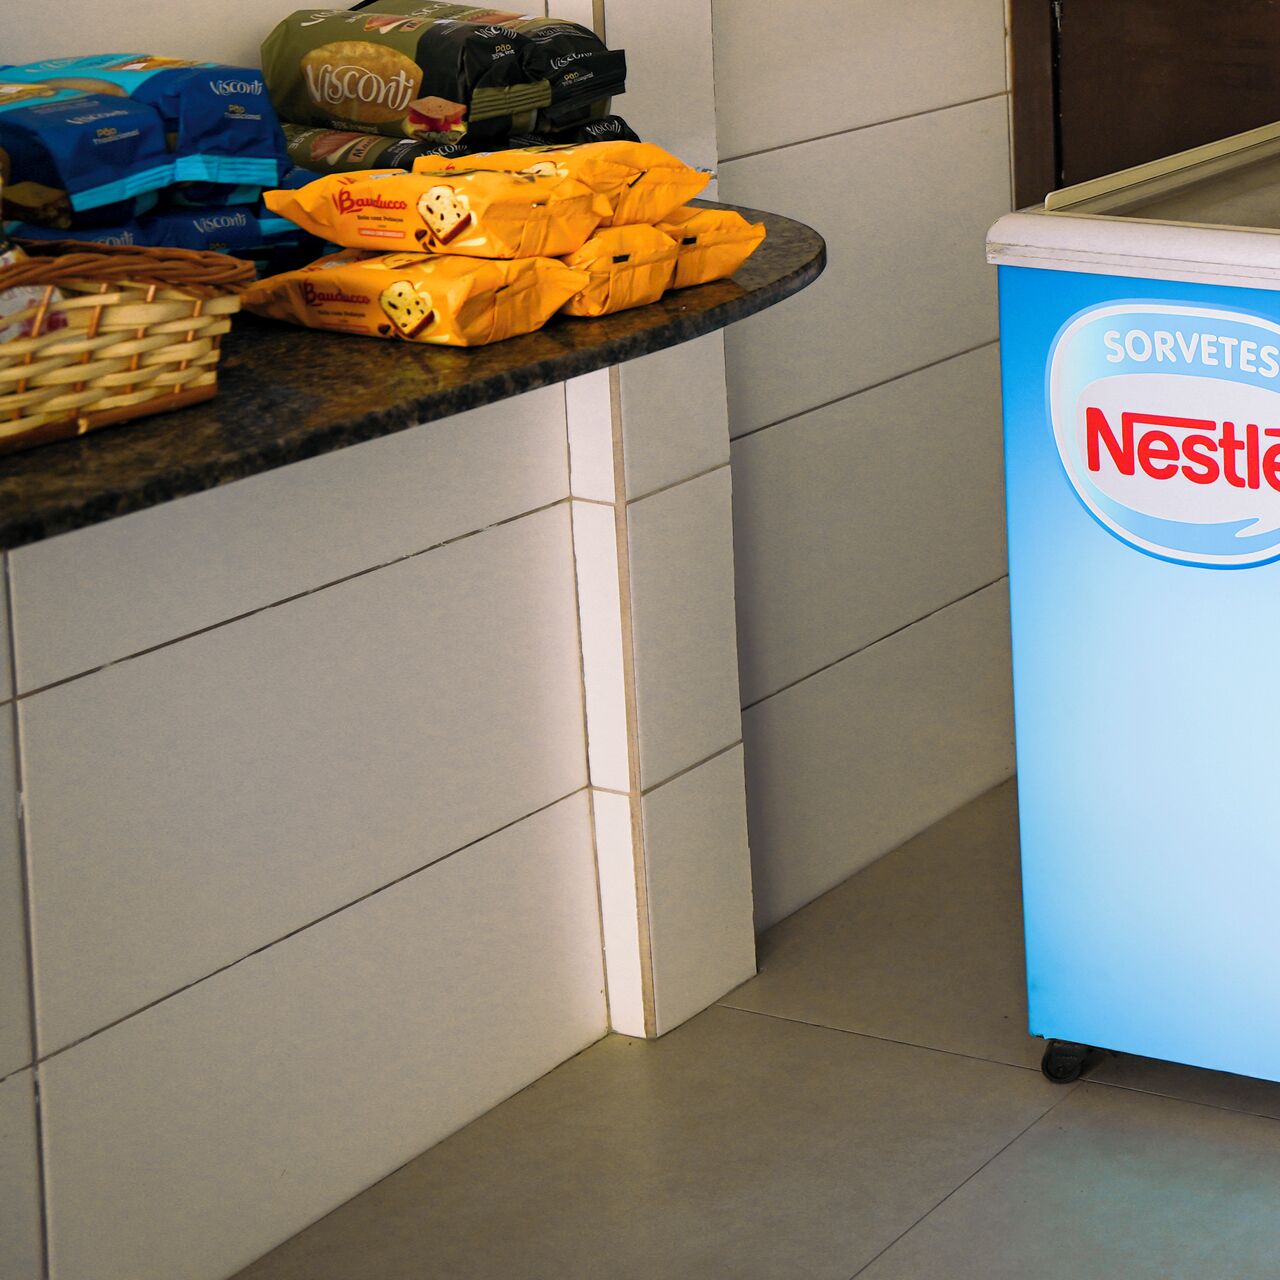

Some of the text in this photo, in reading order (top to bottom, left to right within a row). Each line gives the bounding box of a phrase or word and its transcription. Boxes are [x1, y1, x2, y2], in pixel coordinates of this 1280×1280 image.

[210, 80, 263, 95] Visconti
[306, 64, 414, 111] Visconti
[338, 187, 407, 215] Bauducco
[193, 213, 246, 232] Visconti
[304, 278, 370, 306] Bauducco
[1103, 330, 1280, 378] SORVETES
